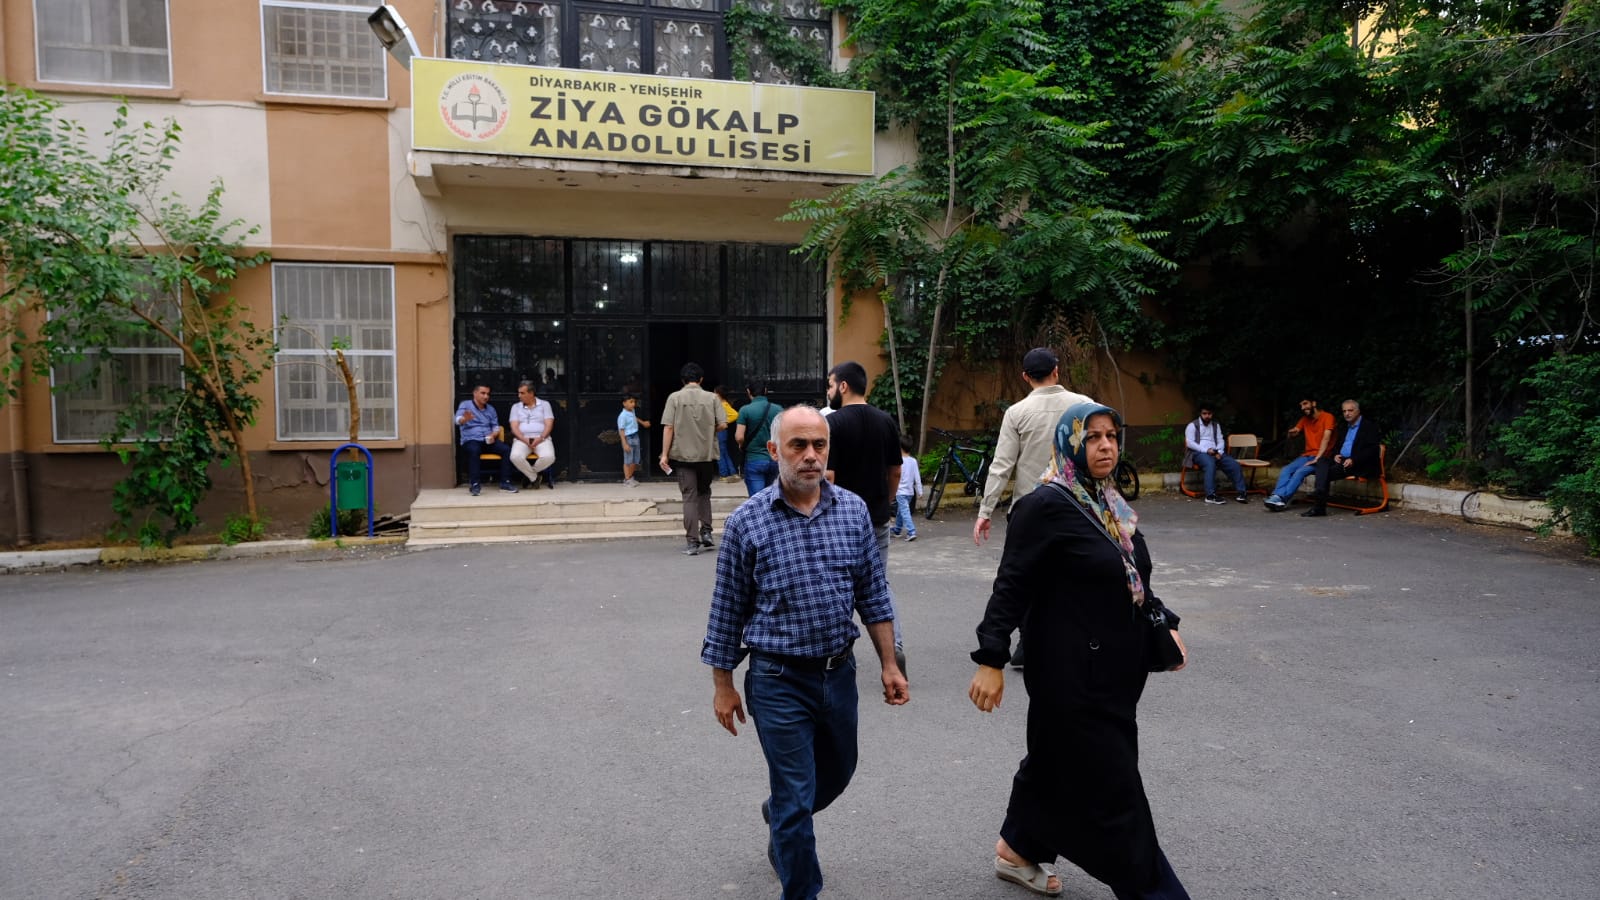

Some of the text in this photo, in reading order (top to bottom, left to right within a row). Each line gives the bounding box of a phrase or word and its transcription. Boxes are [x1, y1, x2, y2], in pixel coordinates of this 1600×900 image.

[530, 76, 617, 93] DİYARBAKIR
[630, 83, 703, 99] YENİŞEHİR
[530, 92, 799, 135] ZİYA GÖKALP
[530, 128, 811, 163] ANADOLU LİSESİ
